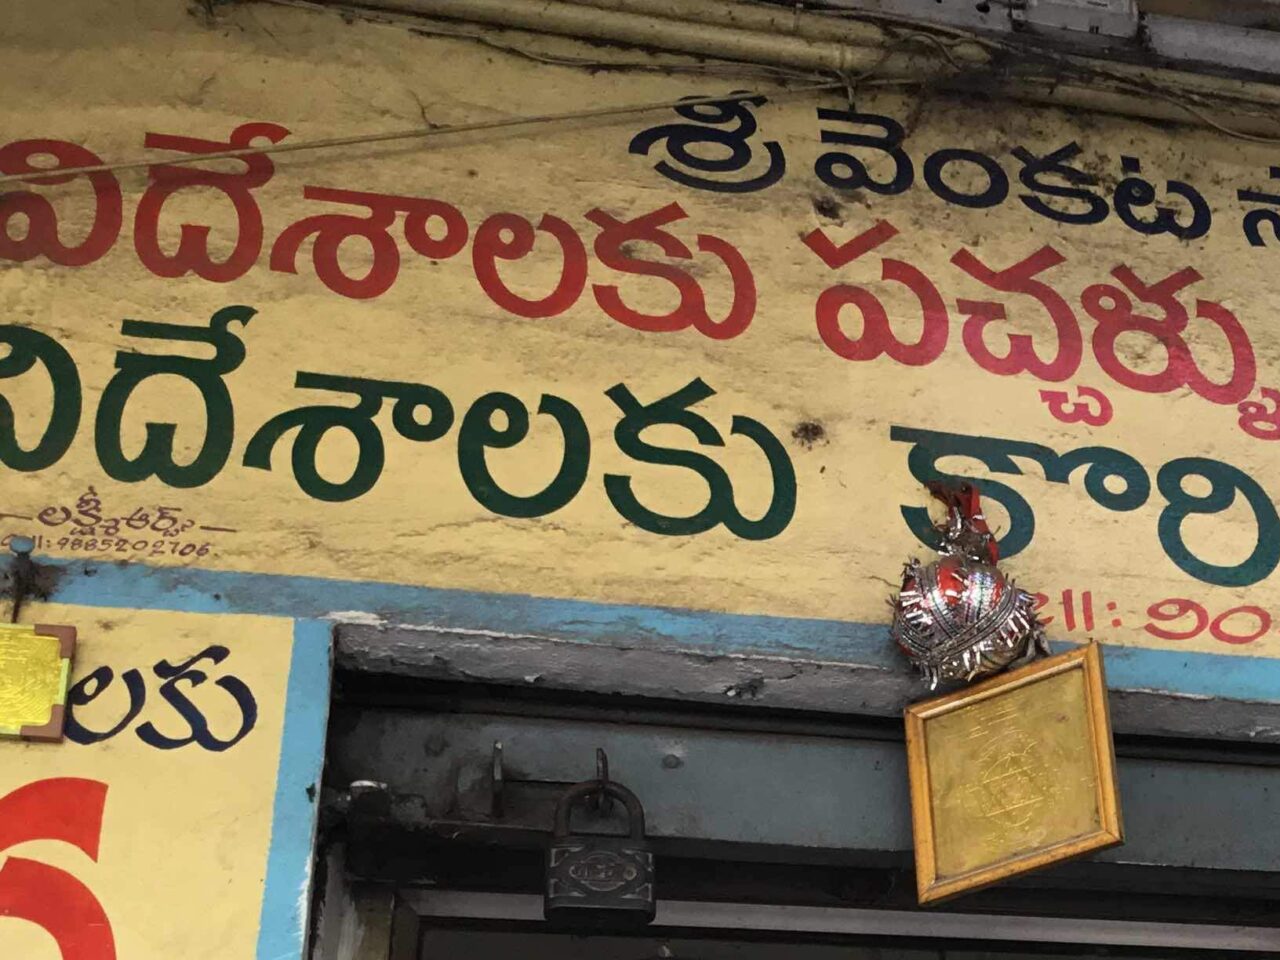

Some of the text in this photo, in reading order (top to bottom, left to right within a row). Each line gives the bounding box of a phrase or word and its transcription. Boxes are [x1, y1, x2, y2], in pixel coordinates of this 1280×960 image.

[0, 121, 758, 341] విదేశాలకు
[628, 88, 786, 194] శ్రీ
[814, 107, 1212, 240] వెంకట
